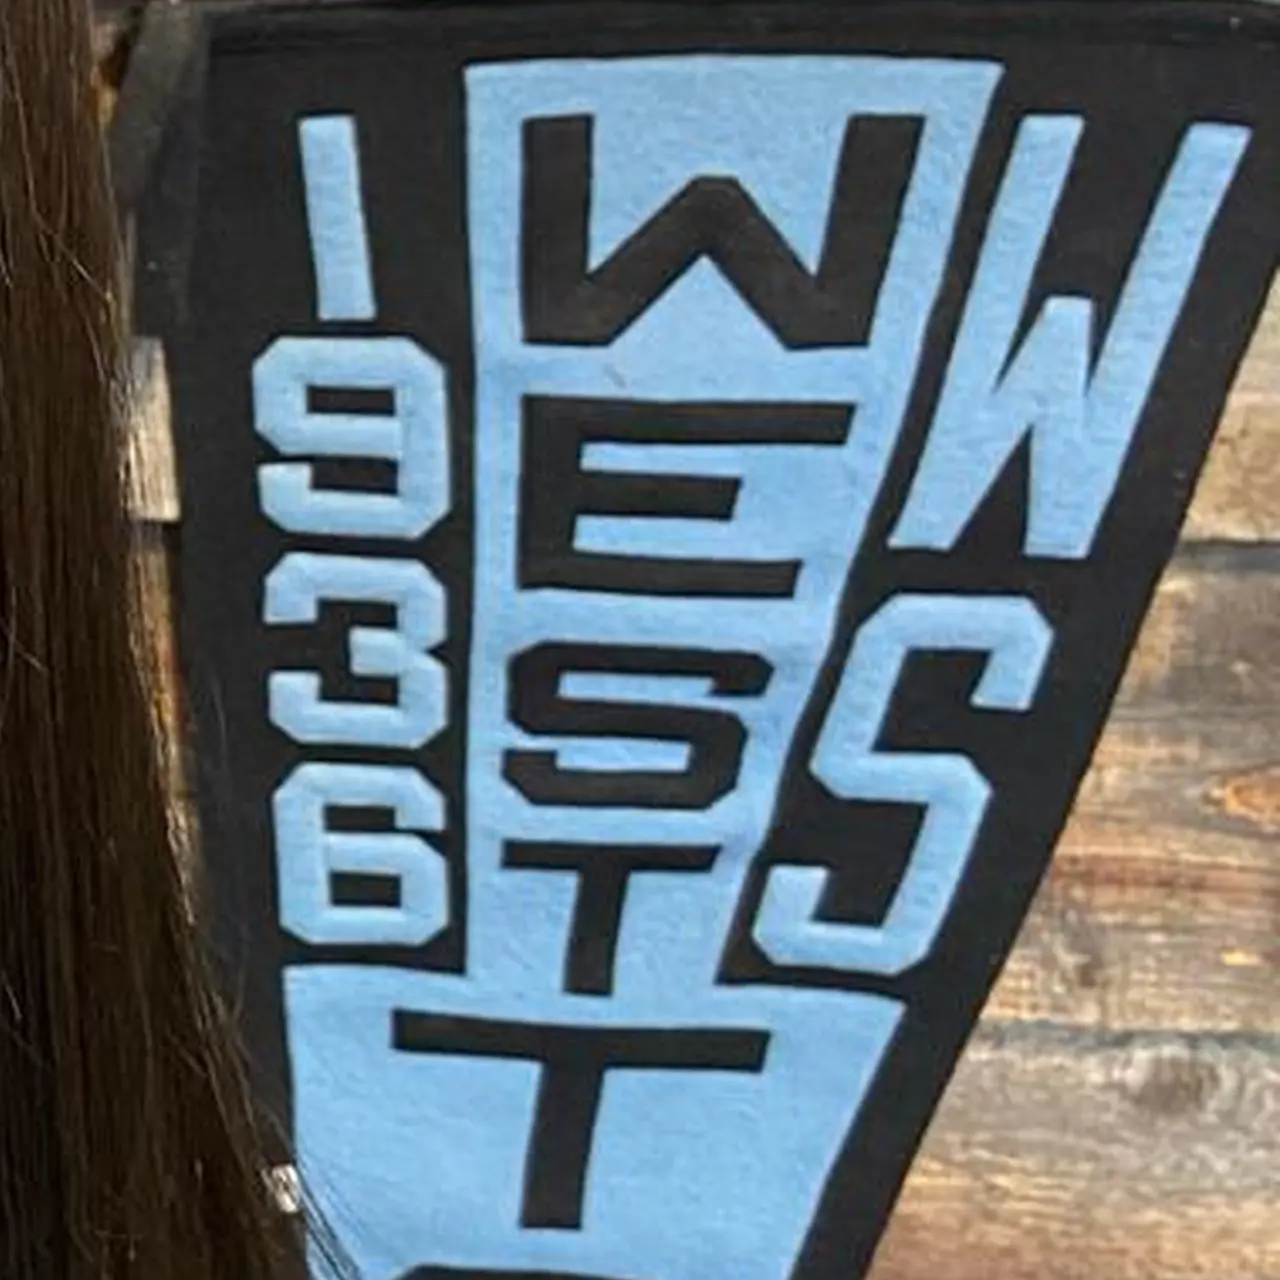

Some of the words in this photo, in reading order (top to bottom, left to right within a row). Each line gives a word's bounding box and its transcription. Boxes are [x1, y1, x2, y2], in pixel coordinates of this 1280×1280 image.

[251, 115, 452, 946] 1936
[500, 113, 928, 998] WEST
[752, 115, 1252, 975] WS
